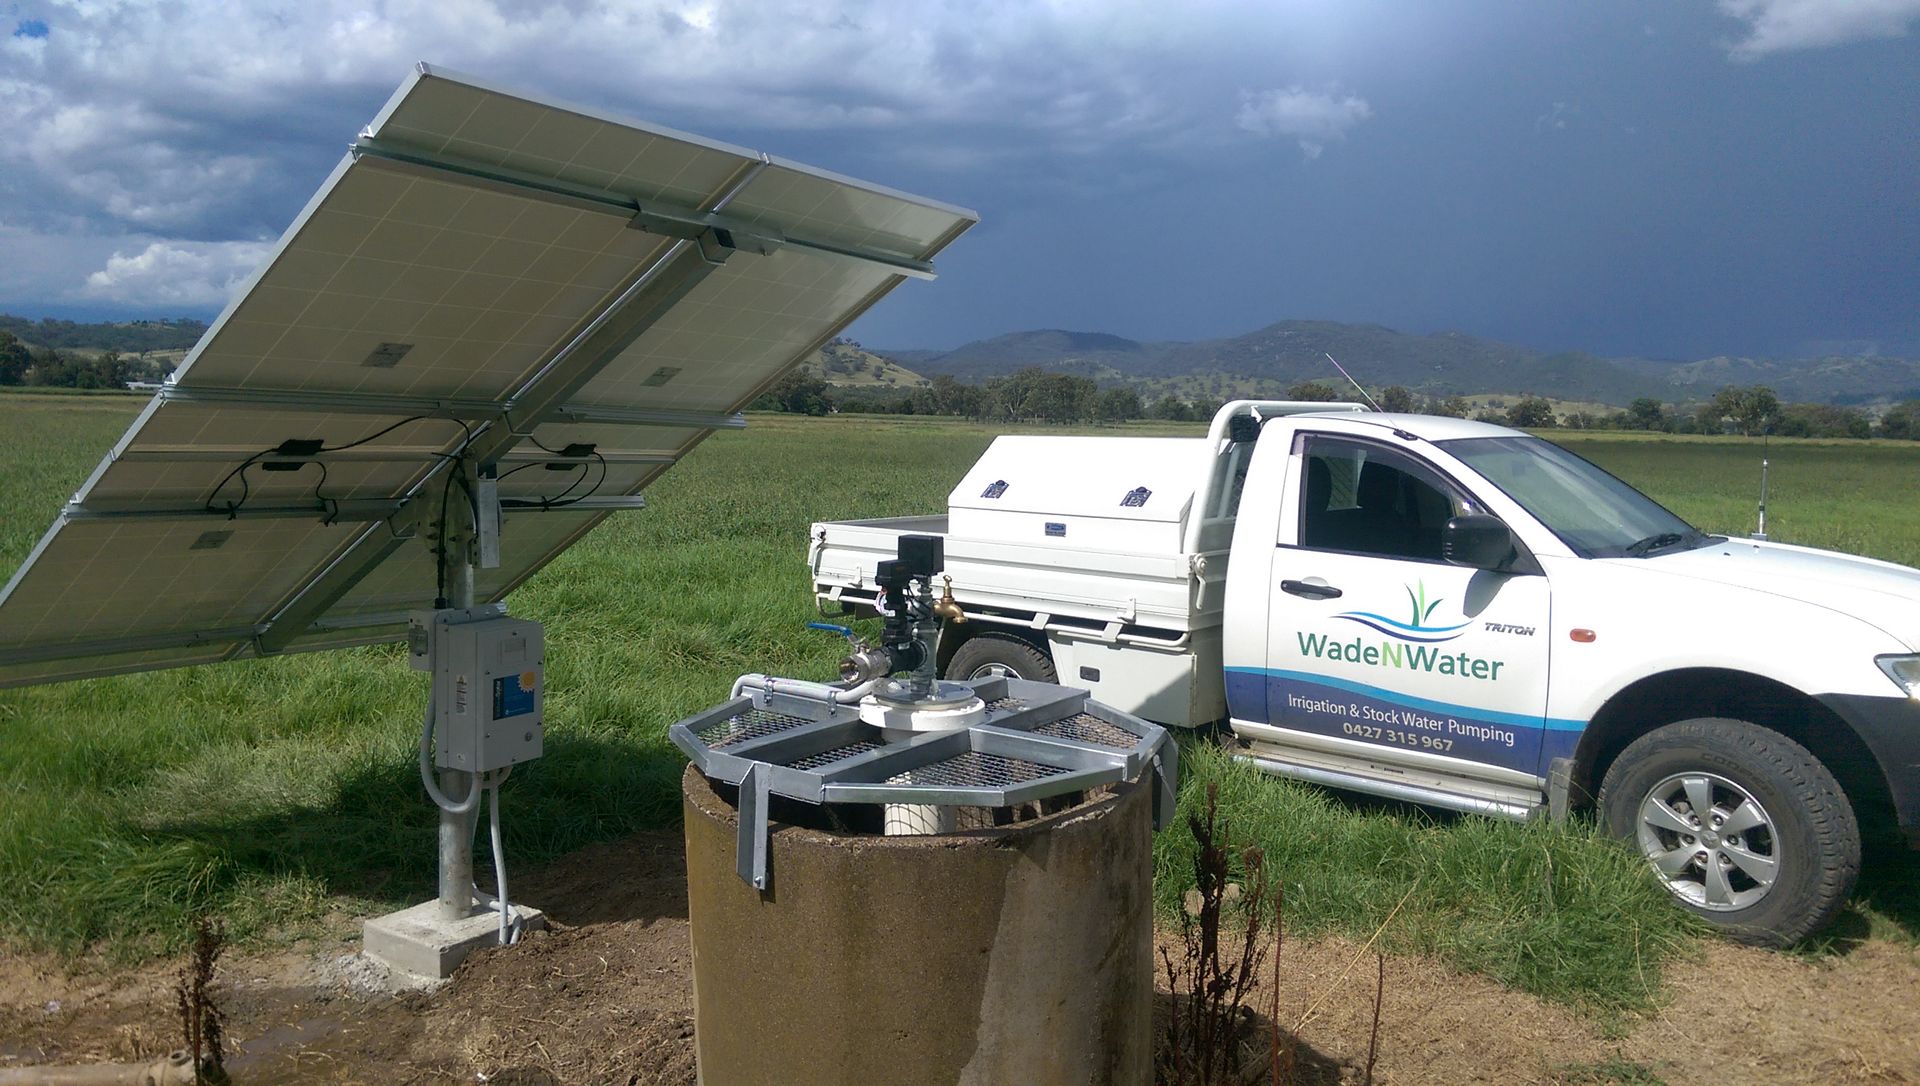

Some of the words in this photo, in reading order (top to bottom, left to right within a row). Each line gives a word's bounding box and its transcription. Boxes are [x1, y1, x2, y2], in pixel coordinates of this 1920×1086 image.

[1484, 622, 1537, 637] TRITON
[1297, 631, 1504, 680] WadeNWater
[1288, 693, 1346, 717] Irrigation
[1349, 703, 1360, 717] &
[1363, 706, 1400, 725] Stock
[1402, 712, 1444, 732] Water
[1448, 716, 1515, 747] Pumping
[1343, 722, 1381, 740] 0427
[1387, 729, 1418, 746] 315
[1422, 734, 1453, 752] 967
